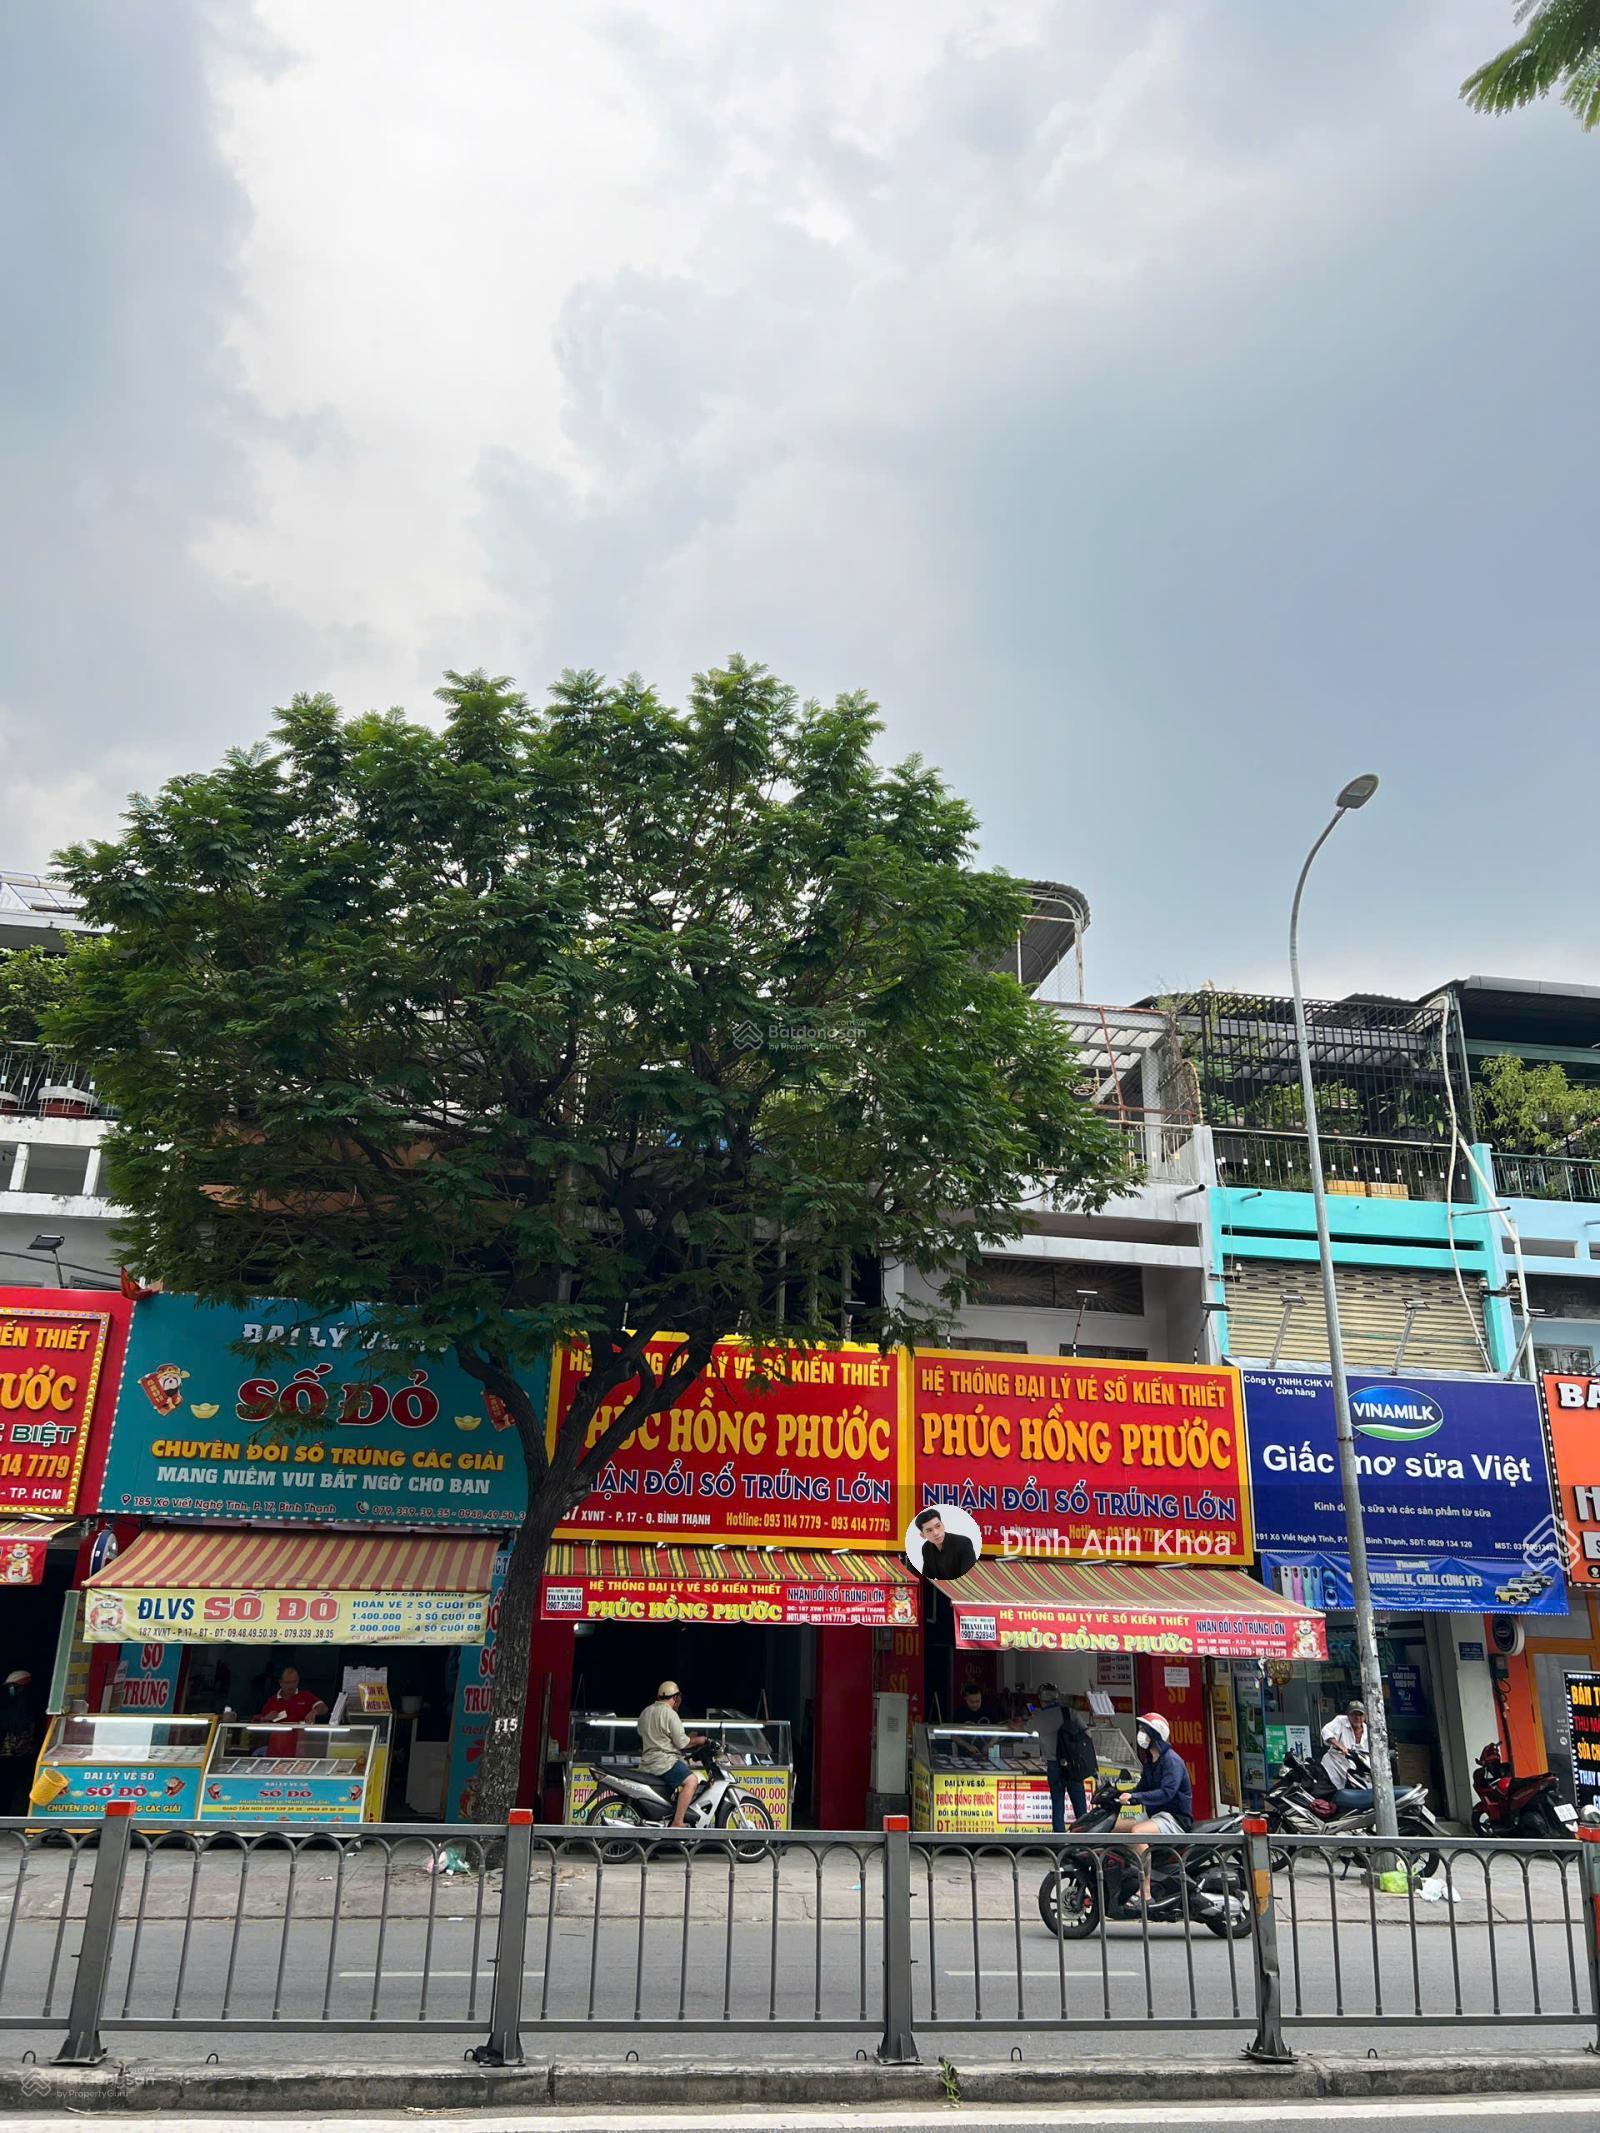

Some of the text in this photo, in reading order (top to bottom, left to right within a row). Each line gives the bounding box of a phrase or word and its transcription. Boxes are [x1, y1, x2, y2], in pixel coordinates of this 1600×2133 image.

[35, 1324, 91, 1350] THIẾT
[791, 1353, 891, 1388] KIẾN THIẾT
[1243, 1375, 1323, 1388] Công ty TNHH CHK
[235, 1363, 440, 1429] SỐ ĐỎ
[921, 1365, 1226, 1408] HỆ THỐNG ĐẠI LÝ VÉ SỐ KIẾN THIẾT
[1294, 1388, 1317, 1398] hàng
[1352, 1402, 1436, 1421] VINAMILK
[10, 1420, 77, 1448] BIỆT
[667, 1386, 891, 1462] HỒNG PHƯỚC
[921, 1402, 1232, 1470] PHÚC HỒNG PHƯỚC
[26, 1455, 70, 1478] 7779
[151, 1440, 241, 1461] CHUYÊN
[294, 1441, 326, 1463] SỐ
[330, 1445, 407, 1467] TRÚNG
[412, 1449, 453, 1470] CÁC
[1262, 1440, 1336, 1474] Giấc
[1405, 1452, 1465, 1480] sữa
[1471, 1453, 1533, 1488] Việt
[157, 1465, 218, 1484] MANG
[282, 1471, 315, 1488] VUI
[319, 1468, 358, 1490] BẤT
[361, 1472, 404, 1492] NGỜ
[408, 1476, 444, 1494] CHO
[449, 1478, 491, 1496] BẠN
[643, 1458, 891, 1505] ĐỔI SỐ TRÚNG LỚN
[10, 1488, 63, 1500] TP. HCM
[133, 1497, 151, 1507] 185
[922, 1475, 1236, 1522] NHẬN ĐỔI SỐ TRÚNG LỚN
[1314, 1501, 1336, 1512] Kinh
[1387, 1504, 1399, 1515] và
[1399, 1504, 1415, 1515] các
[581, 1510, 892, 1533] XVNT P. 17 Q. BÌNH THẠNH Hotline: 093 114 7779 093 414 7779
[589, 1578, 782, 1595] HỆ THỐNG ĐẠI LÝ VÉ SỐ KIẾN THIẾT
[1416, 1574, 1441, 1587] CHILL
[1441, 1574, 1465, 1588] CÙNG
[137, 1589, 339, 1622] ĐLVS SỐ ĐỎ
[352, 1612, 402, 1621] 1.400.000
[406, 1601, 414, 1609] 2
[648, 1594, 709, 1620] HỒNG
[711, 1600, 783, 1621] PHƯỚC
[350, 1624, 401, 1632] 2.000.000
[999, 1609, 1015, 1623] HỆ
[1018, 1609, 1055, 1622] THỐNG
[1058, 1611, 1077, 1624] ĐẠI
[1079, 1610, 1093, 1623] LÝ
[1112, 1611, 1128, 1625] SỐ
[1130, 1613, 1157, 1626] KIẾN
[1160, 1614, 1190, 1627] THIẾT
[153, 1627, 171, 1638] XVNT
[1060, 1625, 1121, 1651] HỒNG
[1123, 1632, 1194, 1655] PHƯỚC
[121, 1671, 170, 1709] TRÚNG
[1570, 1682, 1592, 1706] BÁN
[1578, 1769, 1597, 1786] THAY
[86, 1782, 116, 1798] SỐ
